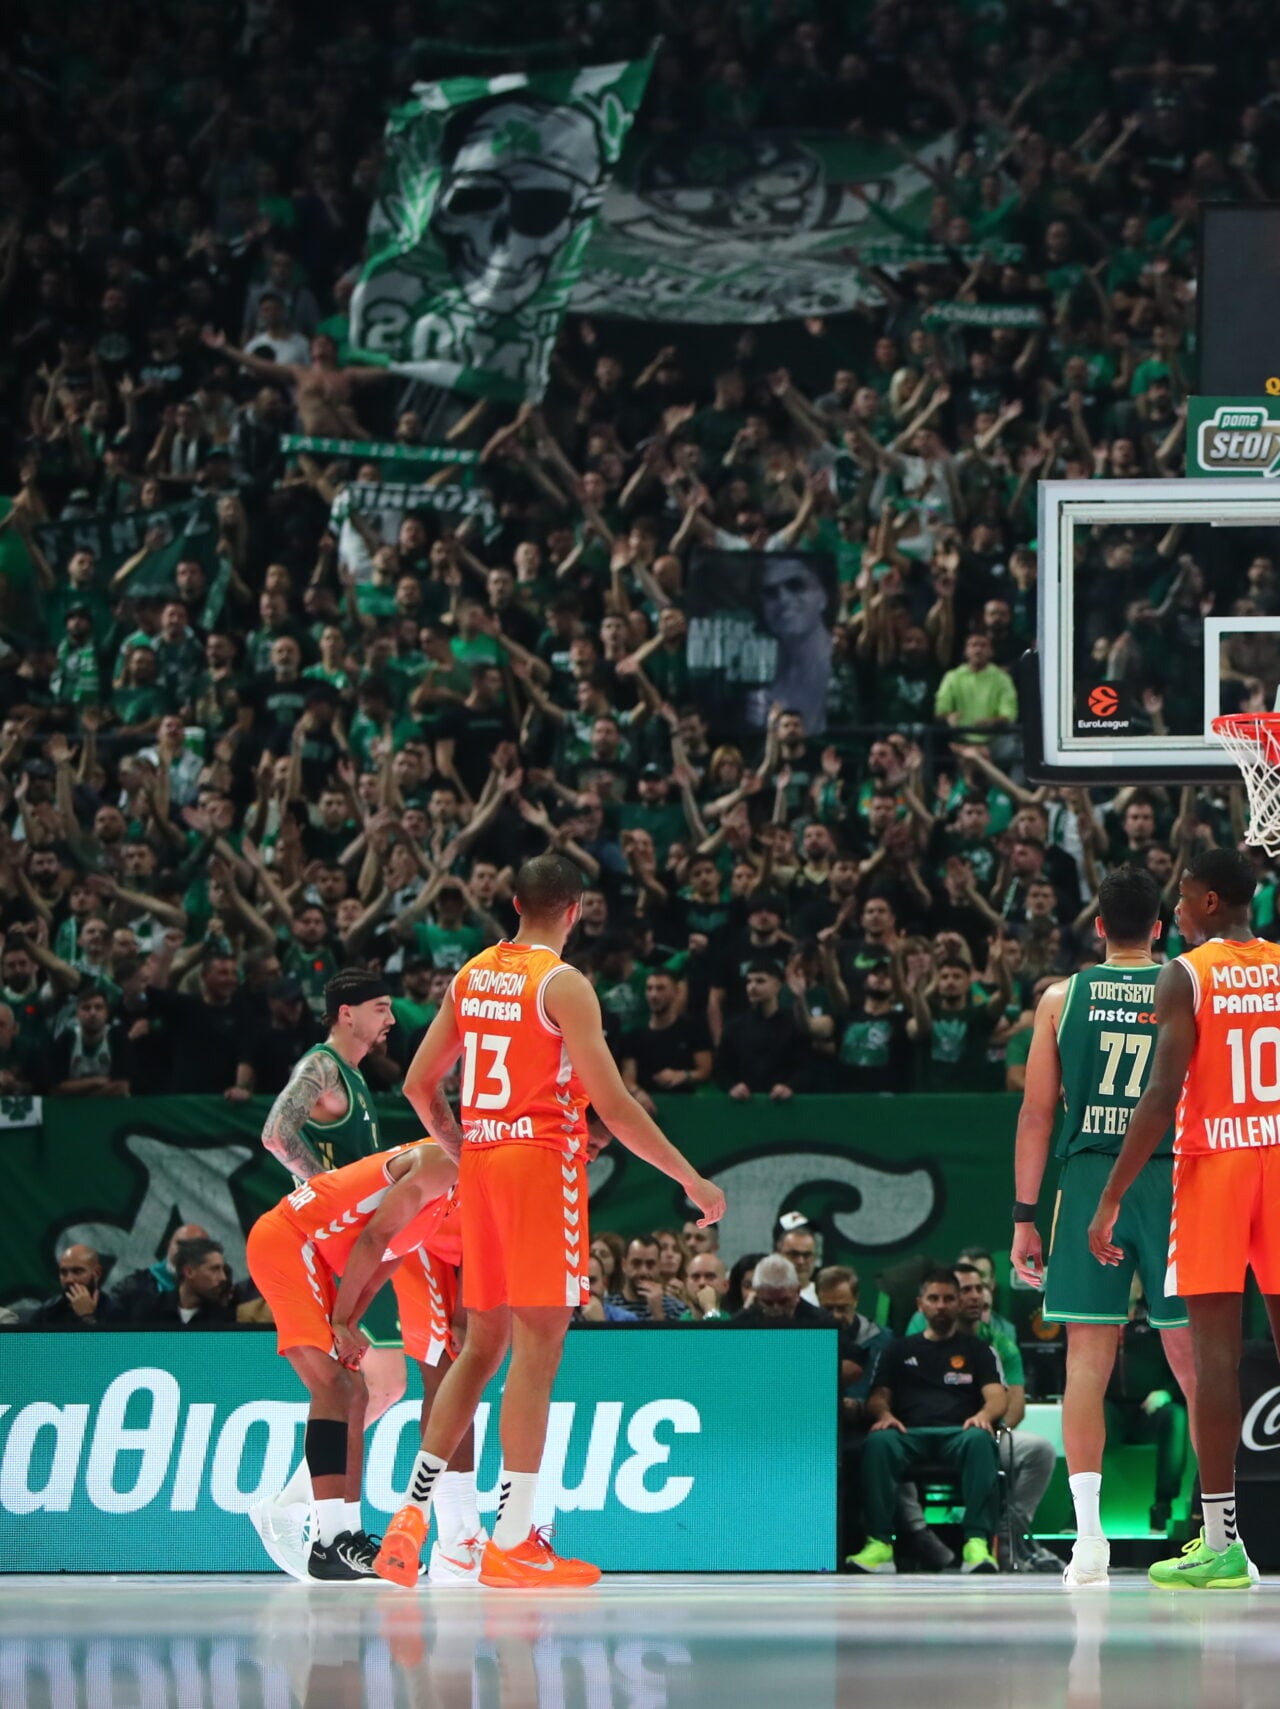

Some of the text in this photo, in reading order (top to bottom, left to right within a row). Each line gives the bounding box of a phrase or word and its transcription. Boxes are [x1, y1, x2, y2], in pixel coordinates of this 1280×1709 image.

[1077, 718, 1130, 731] EuroLeague
[467, 968, 527, 997] THOMPSON
[460, 997, 522, 1022] PAMESA
[461, 1031, 512, 1110] 13
[1098, 1031, 1153, 1098] 77
[1082, 1105, 1137, 1135] ATHE
